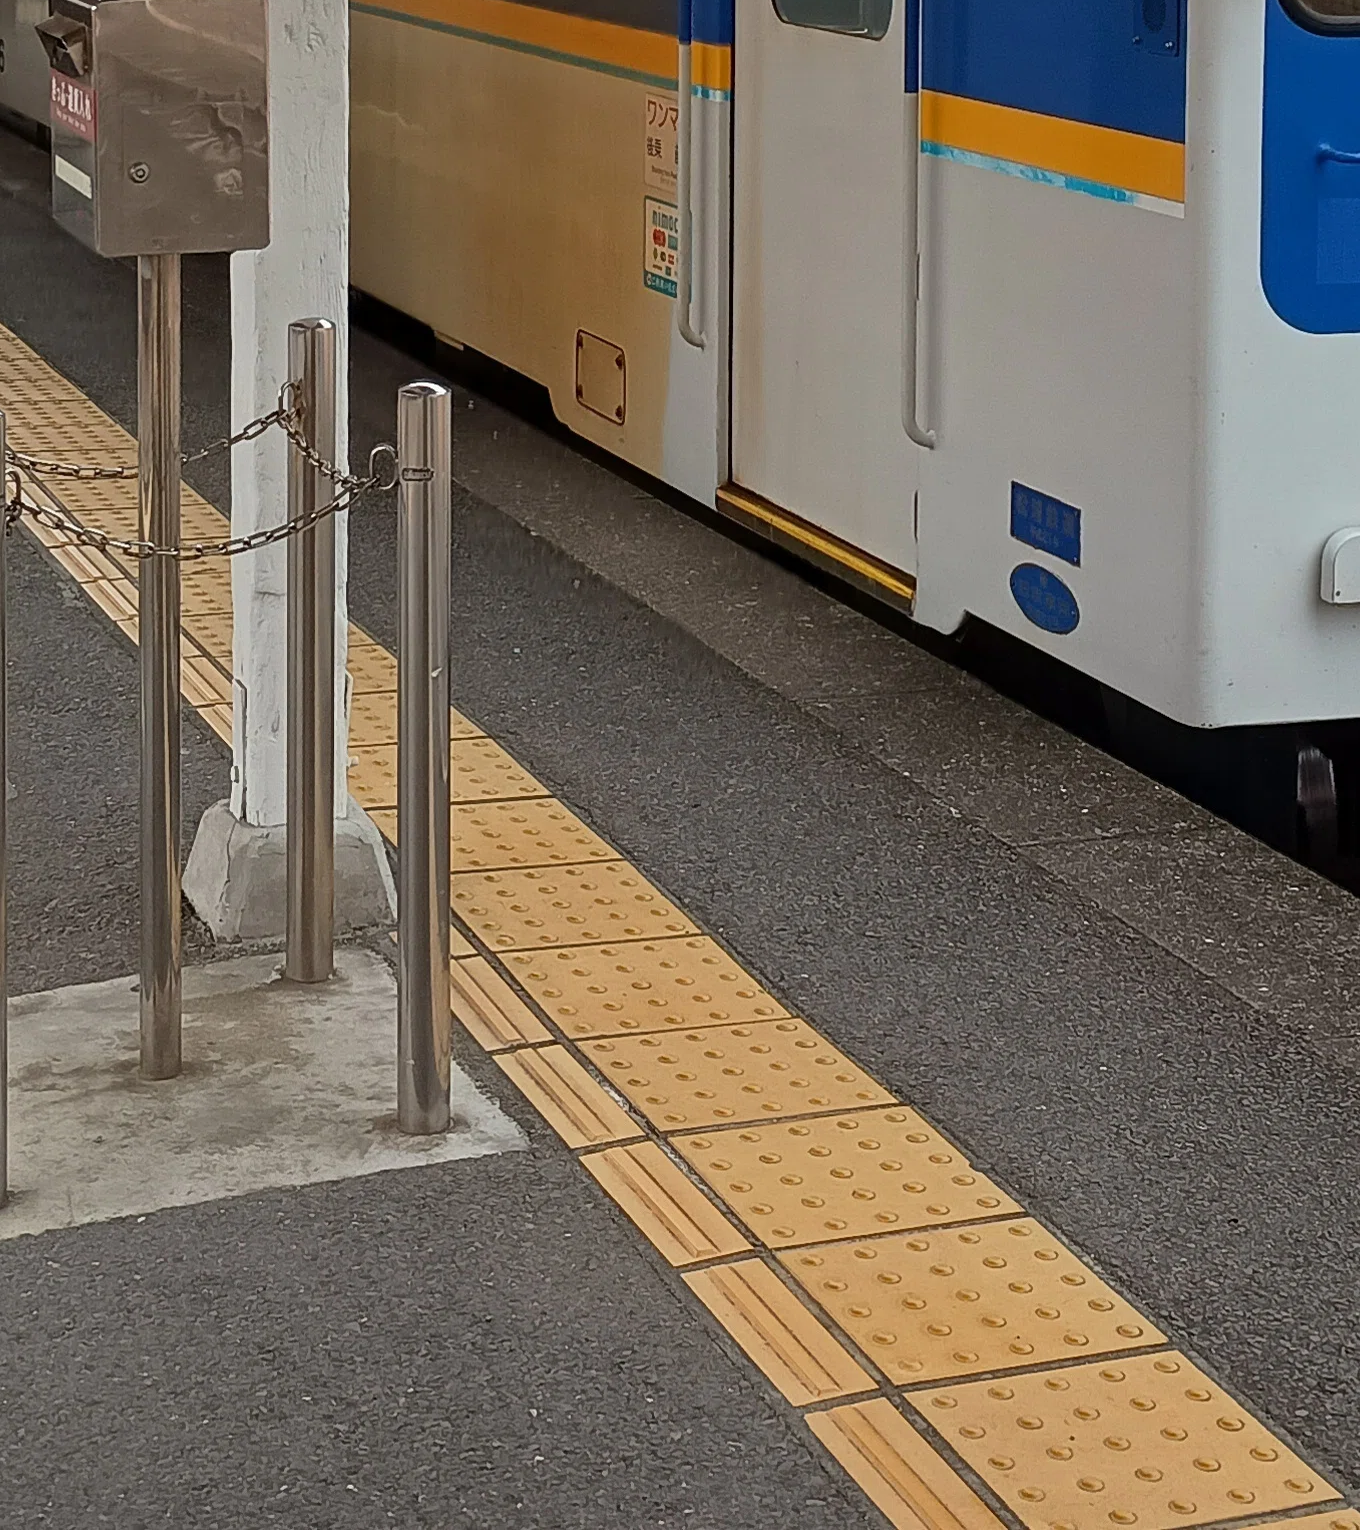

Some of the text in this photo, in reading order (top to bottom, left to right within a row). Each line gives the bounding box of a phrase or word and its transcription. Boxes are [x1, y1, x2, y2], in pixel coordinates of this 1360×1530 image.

[647, 99, 679, 131] ワンマ
[652, 206, 679, 233] nimoc
